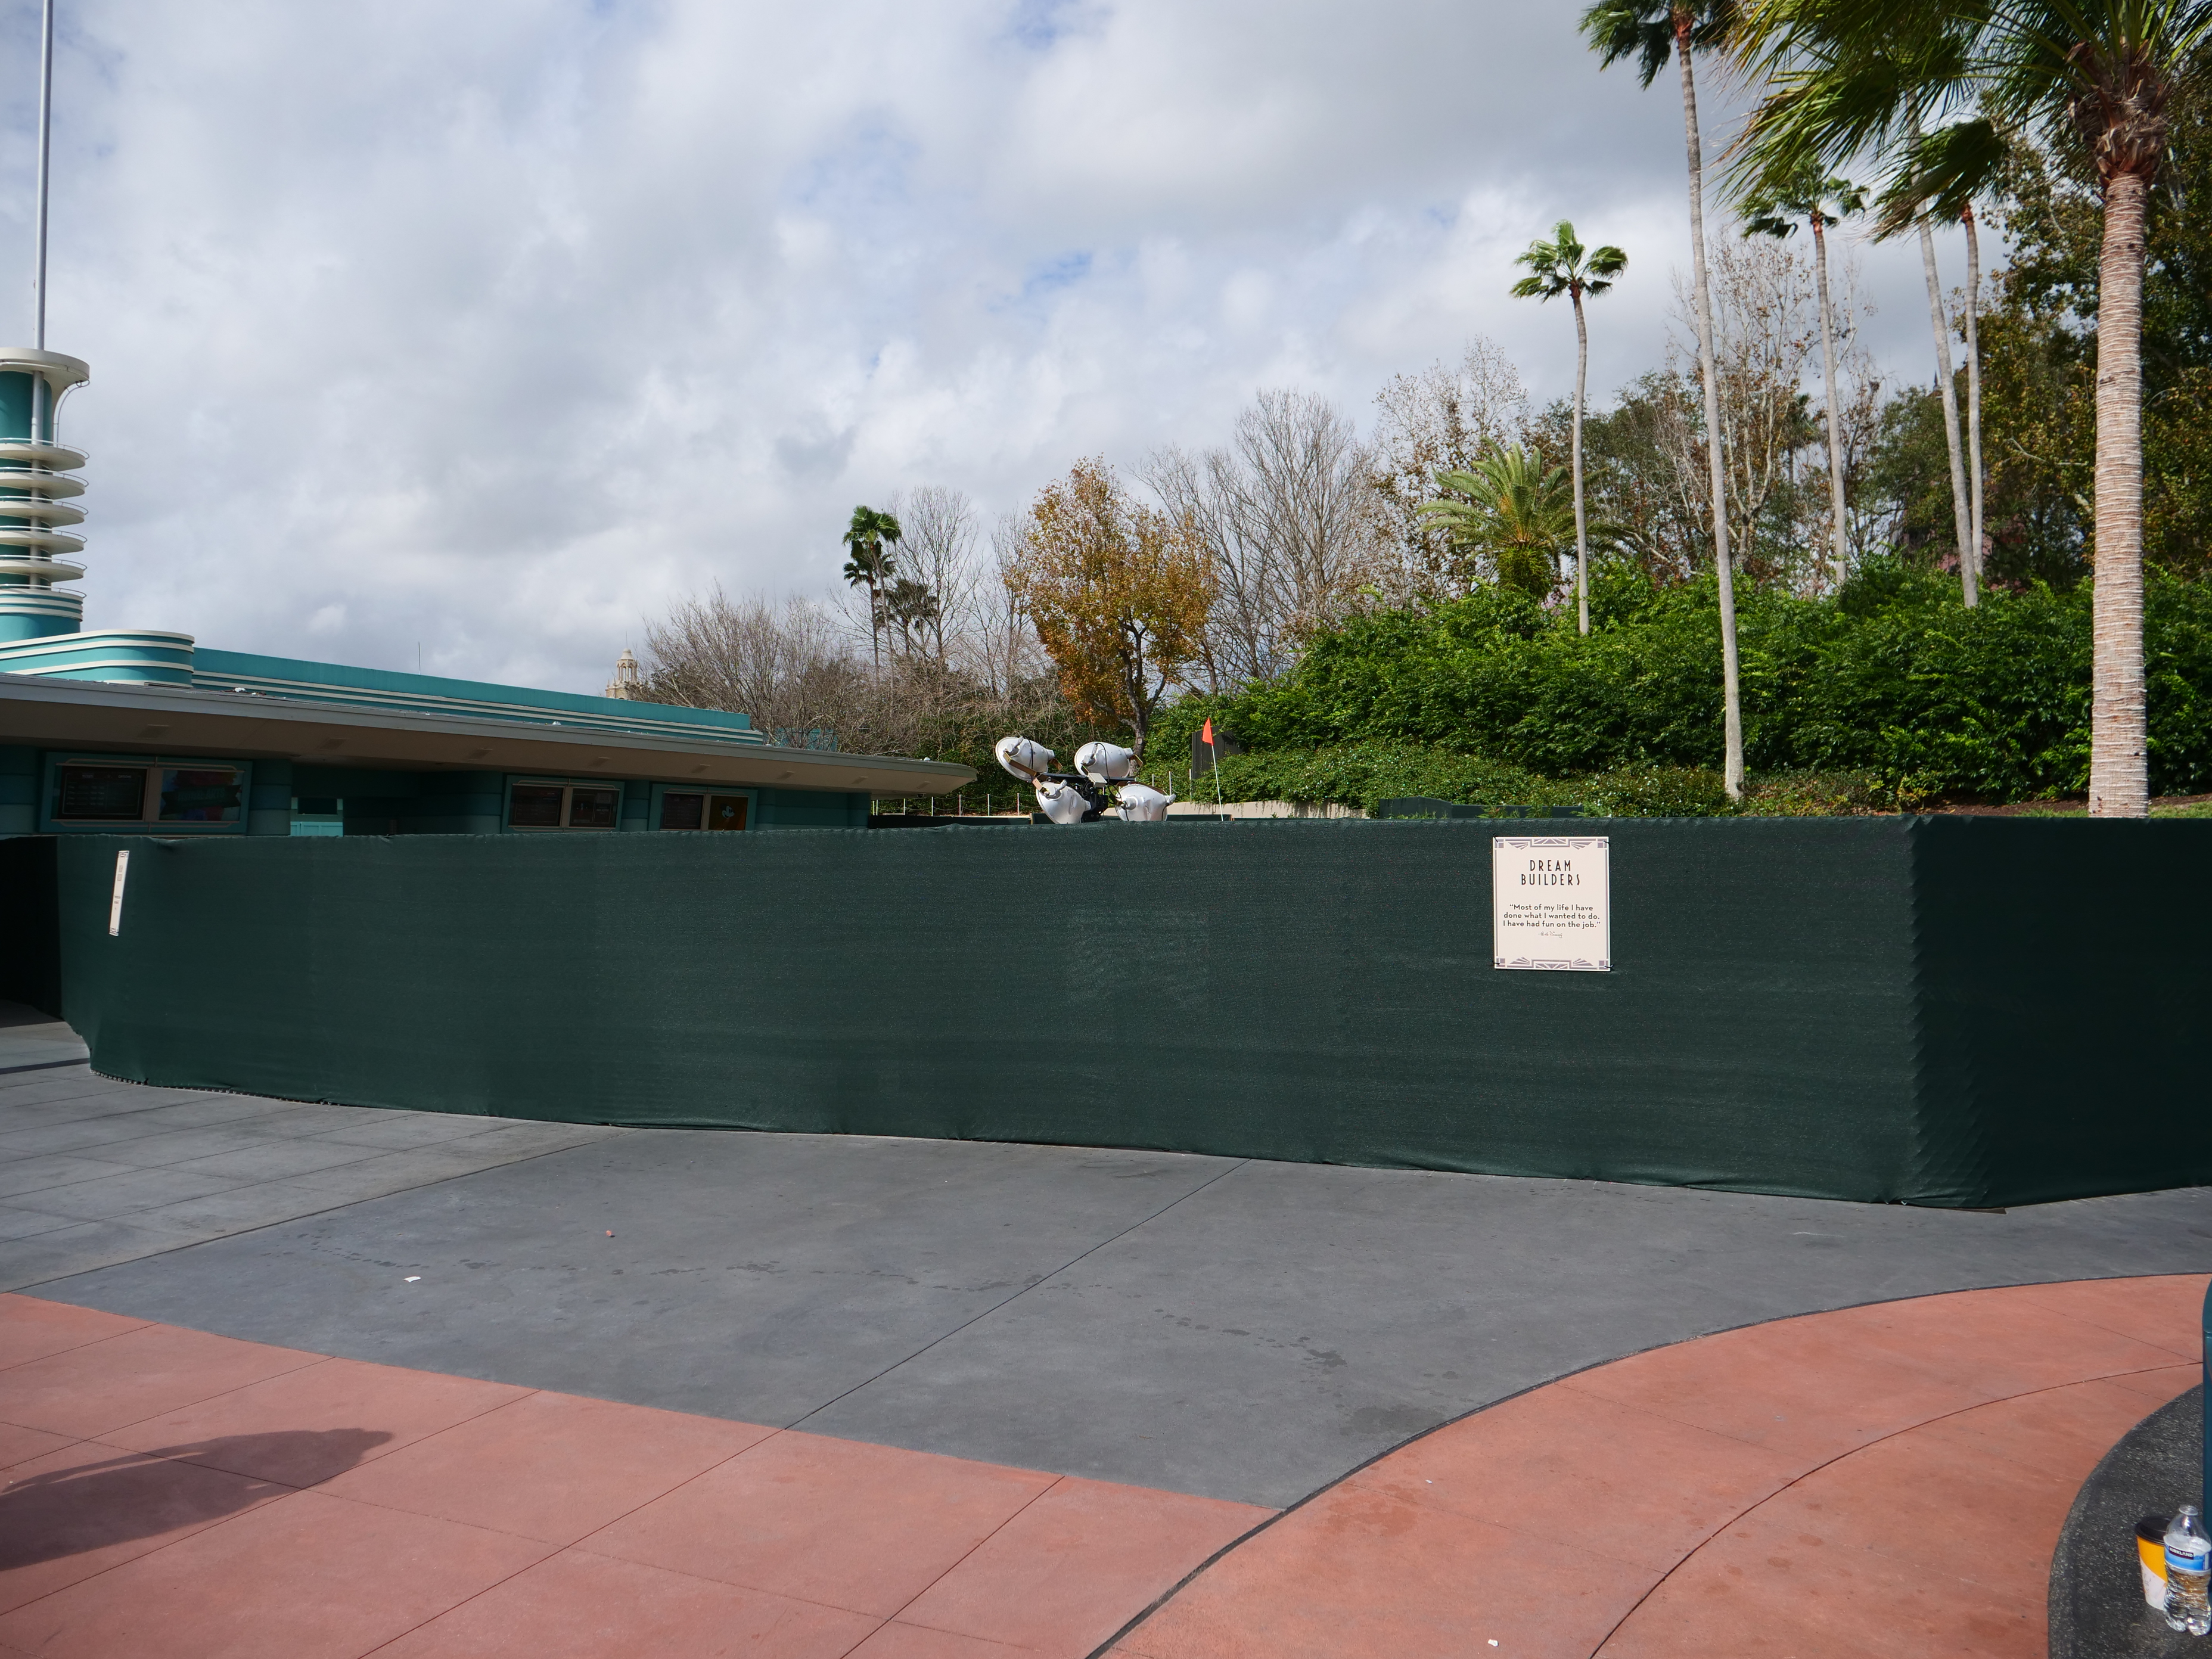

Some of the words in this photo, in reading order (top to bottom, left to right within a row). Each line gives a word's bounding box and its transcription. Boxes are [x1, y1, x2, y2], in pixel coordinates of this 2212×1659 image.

[1530, 859, 1571, 872] DREAM
[1521, 874, 1581, 886] BUILDERS
[2169, 1547, 2194, 1558] KIRKLAND
